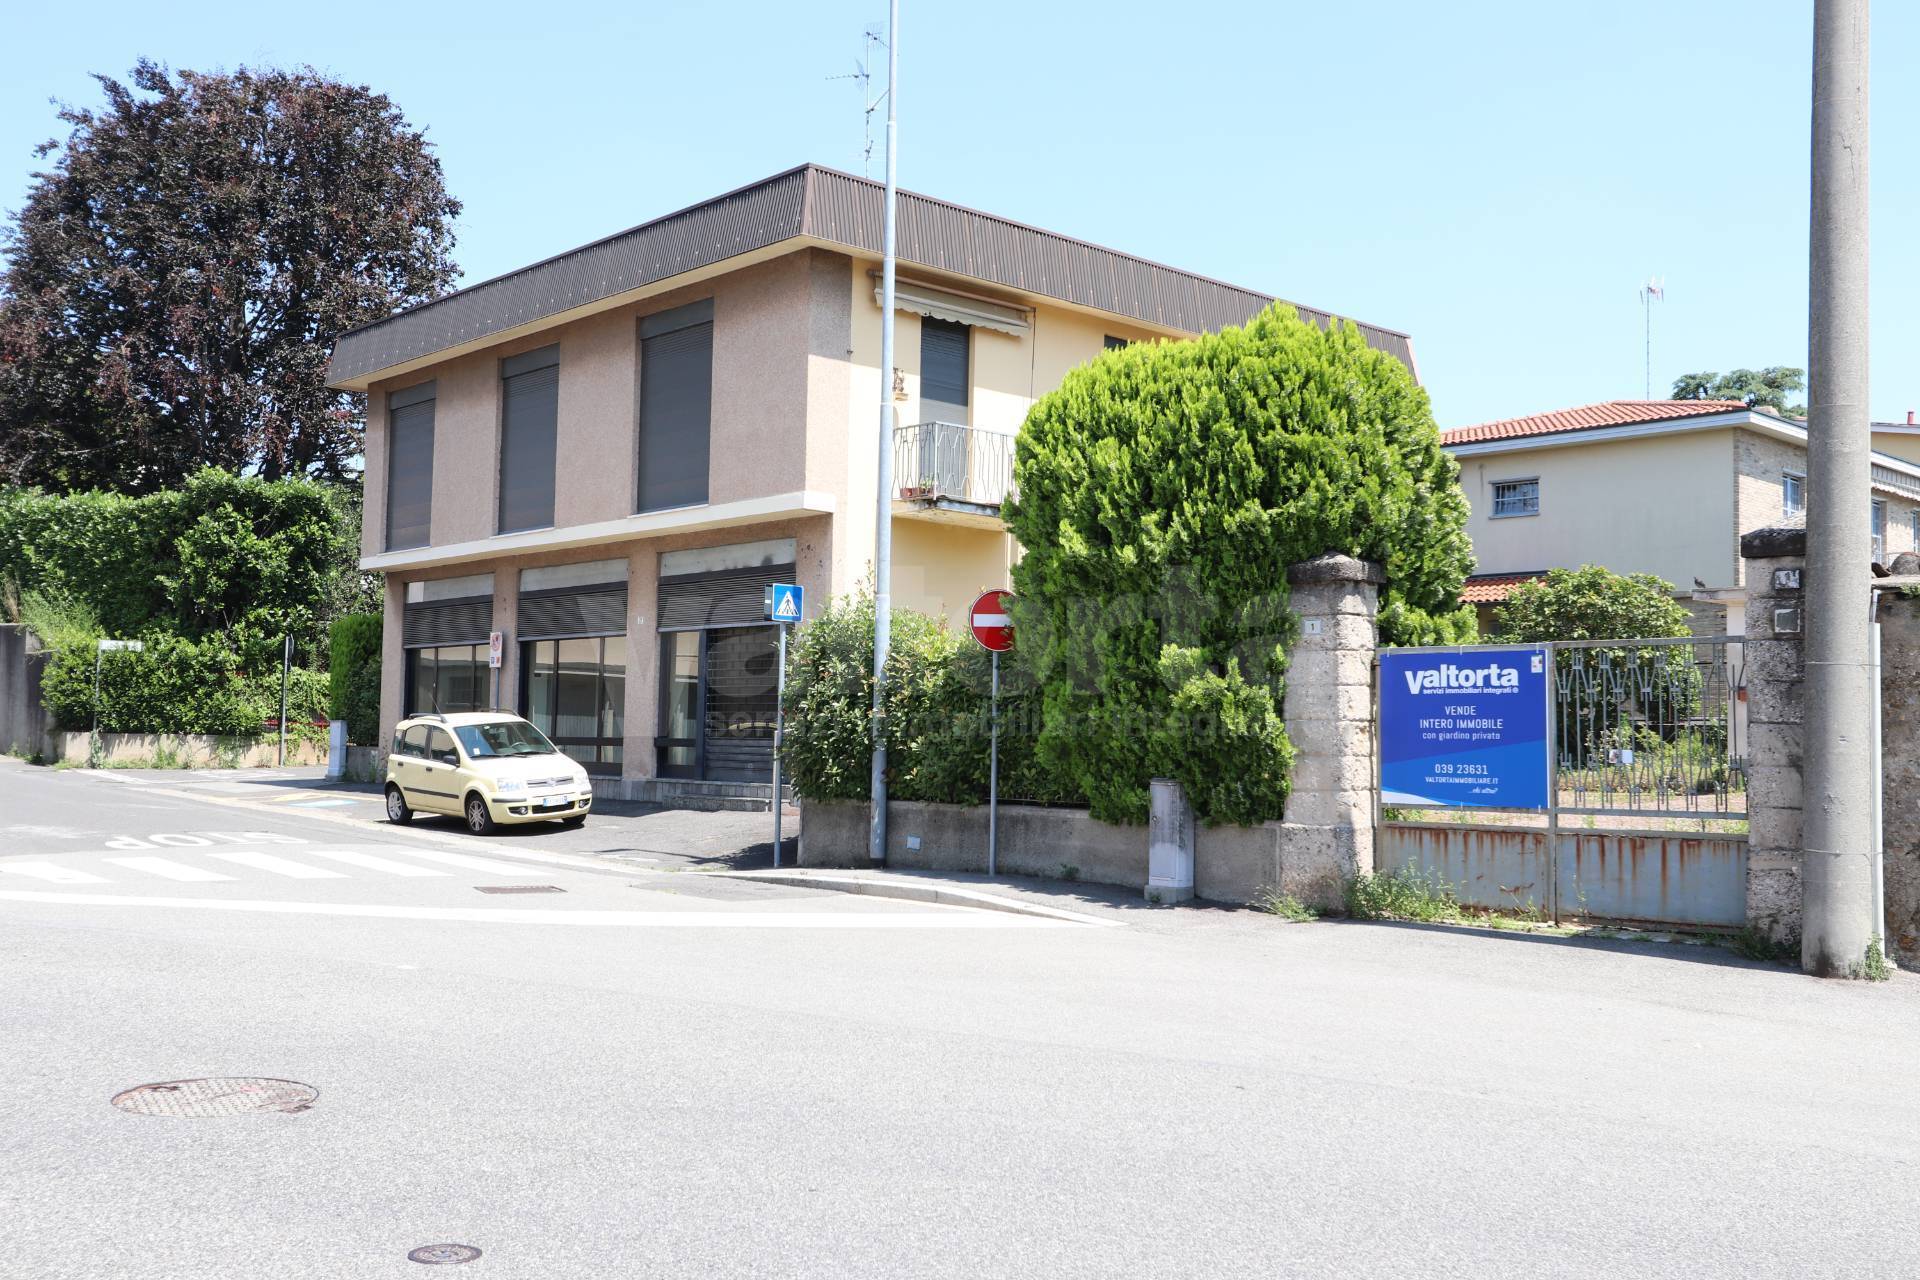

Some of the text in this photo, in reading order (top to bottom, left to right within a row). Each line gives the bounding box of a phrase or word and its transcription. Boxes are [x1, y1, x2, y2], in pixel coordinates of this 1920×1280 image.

[1405, 664, 1519, 694] valtorta
[1483, 687, 1512, 695] integrati
[1444, 705, 1477, 715] VENDE
[1420, 719, 1503, 729] INTERO IMMOBILE
[1439, 731, 1470, 741] giardino
[1472, 732, 1500, 741] privato
[1435, 764, 1488, 775] 039 23631
[1425, 776, 1499, 784] VALTORTAIMMOBILIARE.IT
